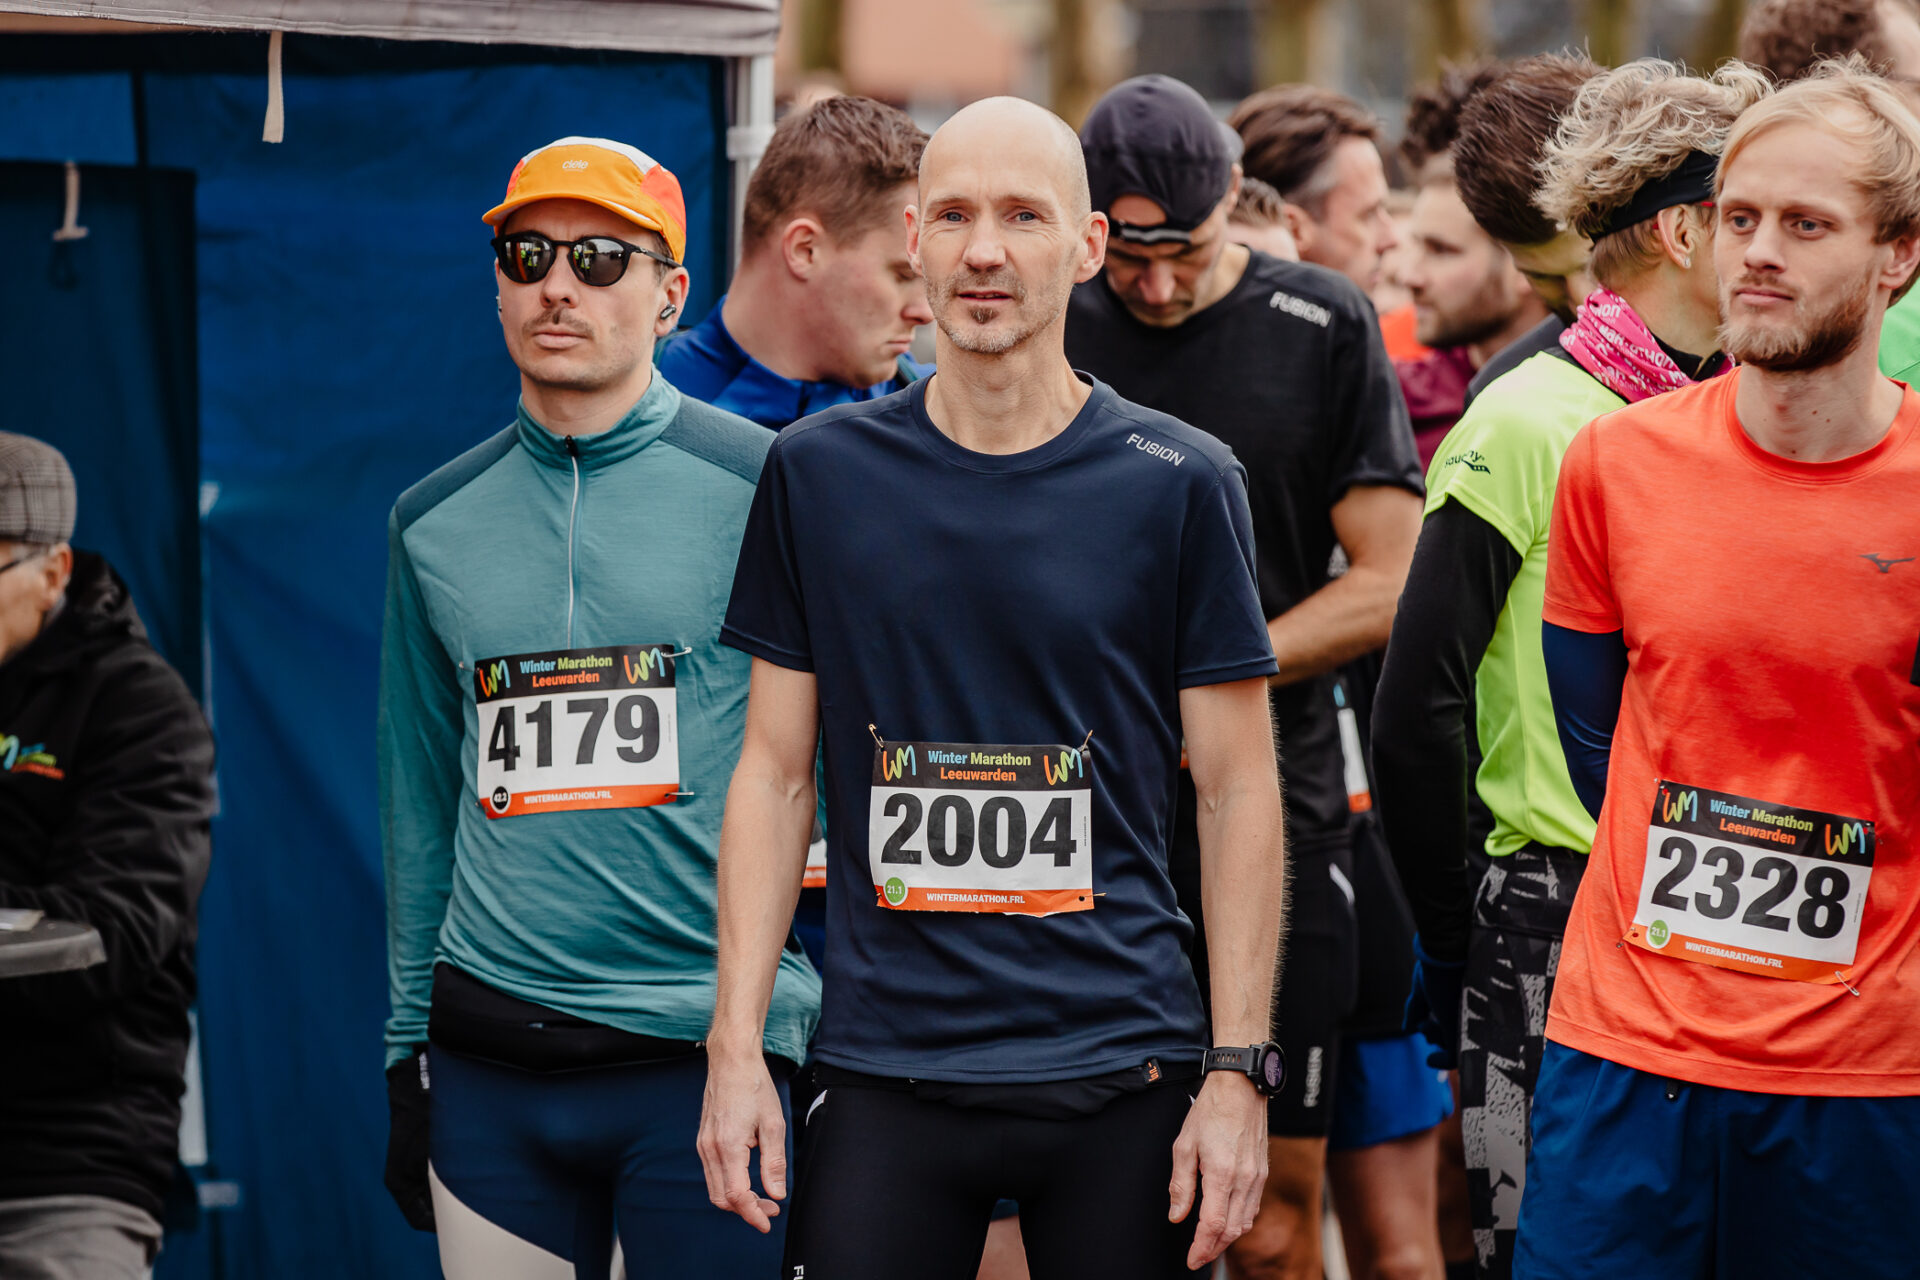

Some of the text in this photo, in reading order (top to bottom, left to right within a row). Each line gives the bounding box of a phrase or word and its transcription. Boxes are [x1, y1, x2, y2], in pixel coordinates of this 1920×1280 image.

[1269, 291, 1331, 327] FUSION
[1126, 433, 1186, 467] FUSION
[519, 655, 613, 674] Winter Marathon
[532, 670, 600, 688] Leeuwarden
[487, 694, 661, 772] 4179
[927, 750, 1032, 767] Winter Marathon
[940, 766, 1017, 782] Leeuwarden
[523, 790, 613, 805] WINTERMARATHON.FRL
[1709, 799, 1814, 832] Winter Marathon
[880, 792, 1077, 869] 2004
[1719, 818, 1796, 845] Leeuwarden
[886, 884, 904, 895] 21.1
[926, 892, 1026, 904] WINTERMARATHON.FRL
[1650, 835, 1850, 939] 2328
[1650, 925, 1667, 939] 21.1
[1684, 941, 1784, 968] WINTERMARATHON.FRL
